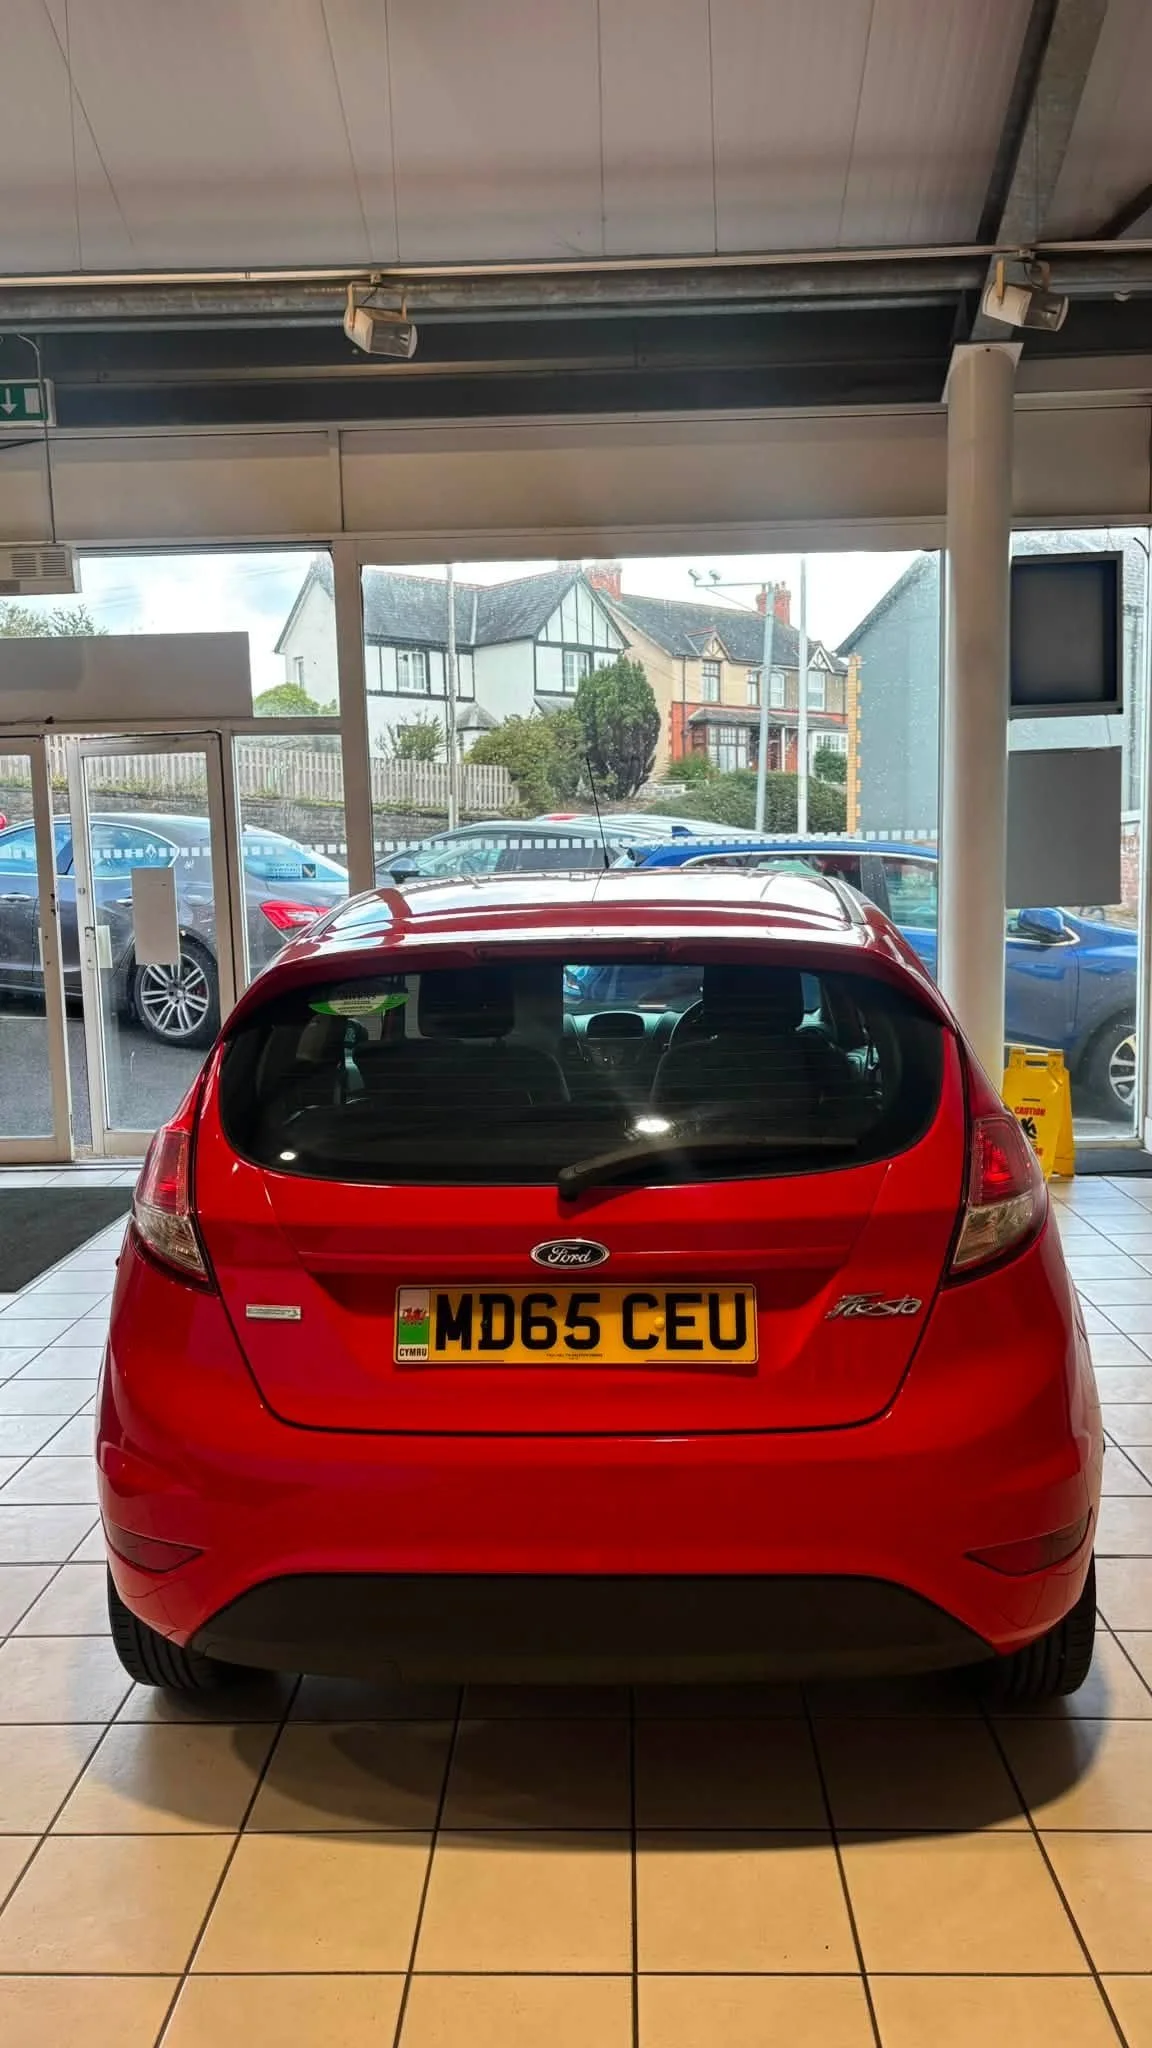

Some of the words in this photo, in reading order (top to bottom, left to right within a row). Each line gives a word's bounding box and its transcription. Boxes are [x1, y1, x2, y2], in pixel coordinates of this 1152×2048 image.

[1014, 1106, 1046, 1116] CAUTION
[547, 1245, 592, 1264] Ford
[824, 1291, 922, 1319] Fiesta
[435, 1293, 601, 1351] MD65
[622, 1293, 747, 1351] CEU
[399, 1347, 427, 1357] CYMRU
